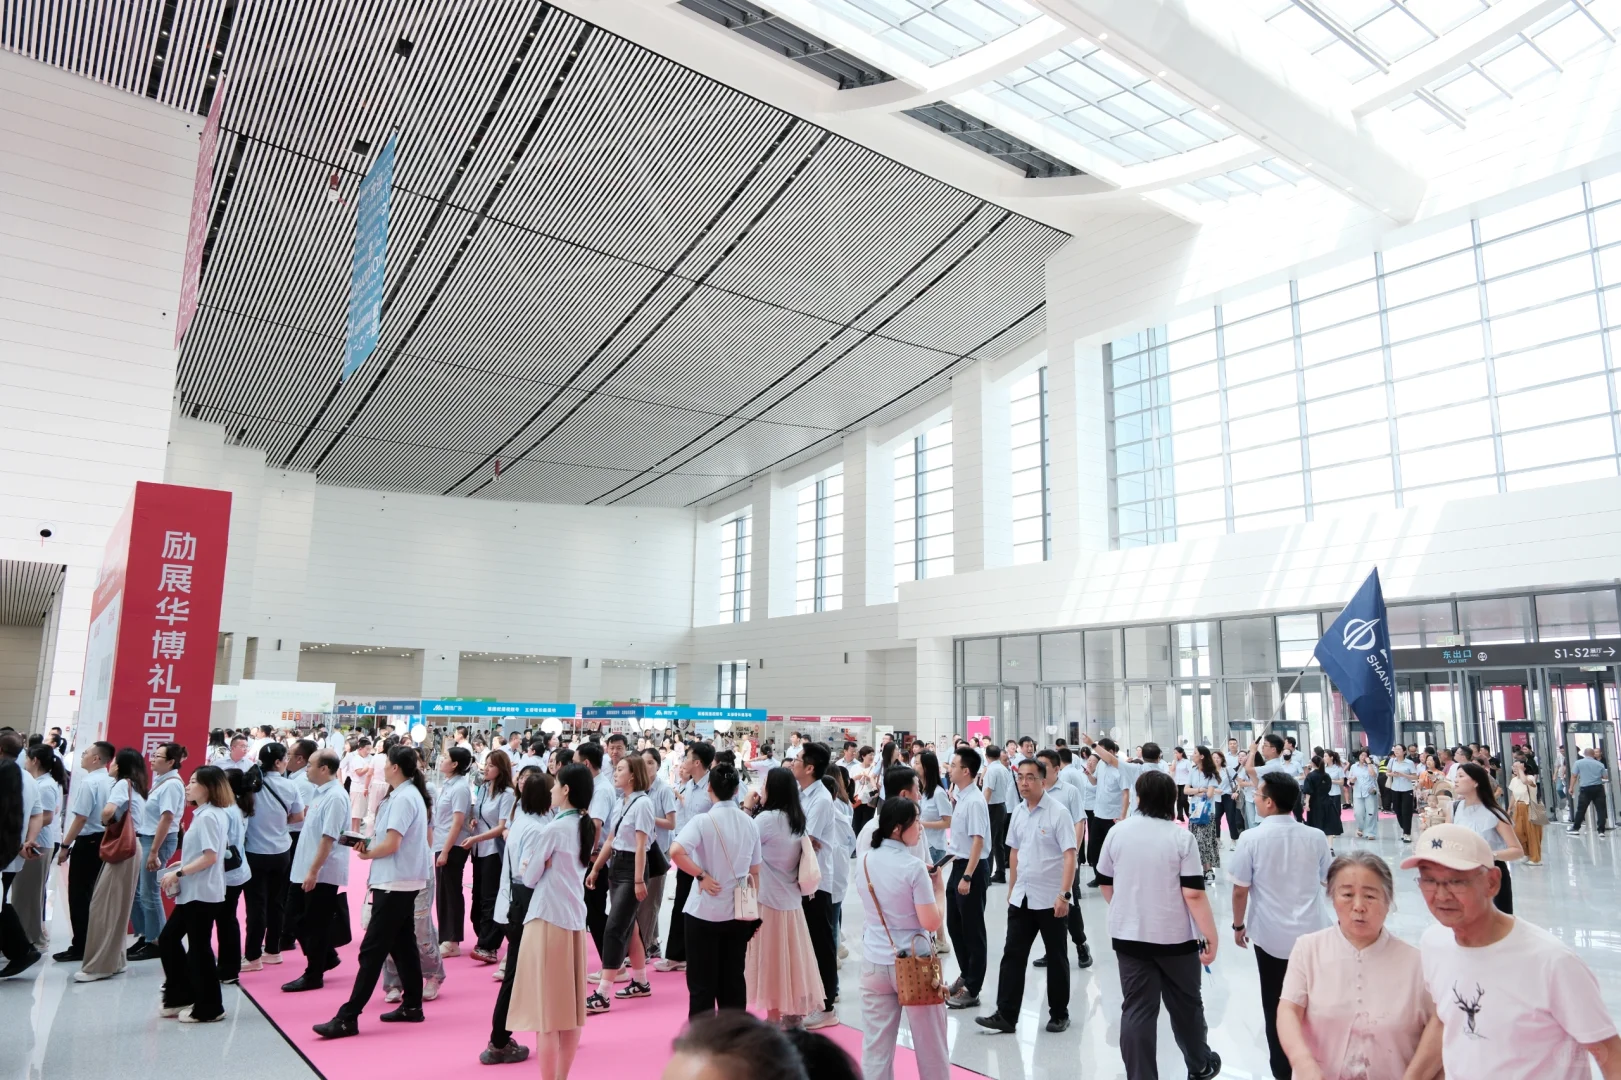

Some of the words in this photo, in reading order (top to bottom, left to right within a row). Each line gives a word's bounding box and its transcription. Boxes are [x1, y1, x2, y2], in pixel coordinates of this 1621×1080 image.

[1442, 649, 1472, 659] 东出口
[1554, 647, 1590, 659] S1-S2
[1367, 654, 1393, 697] SHANX
